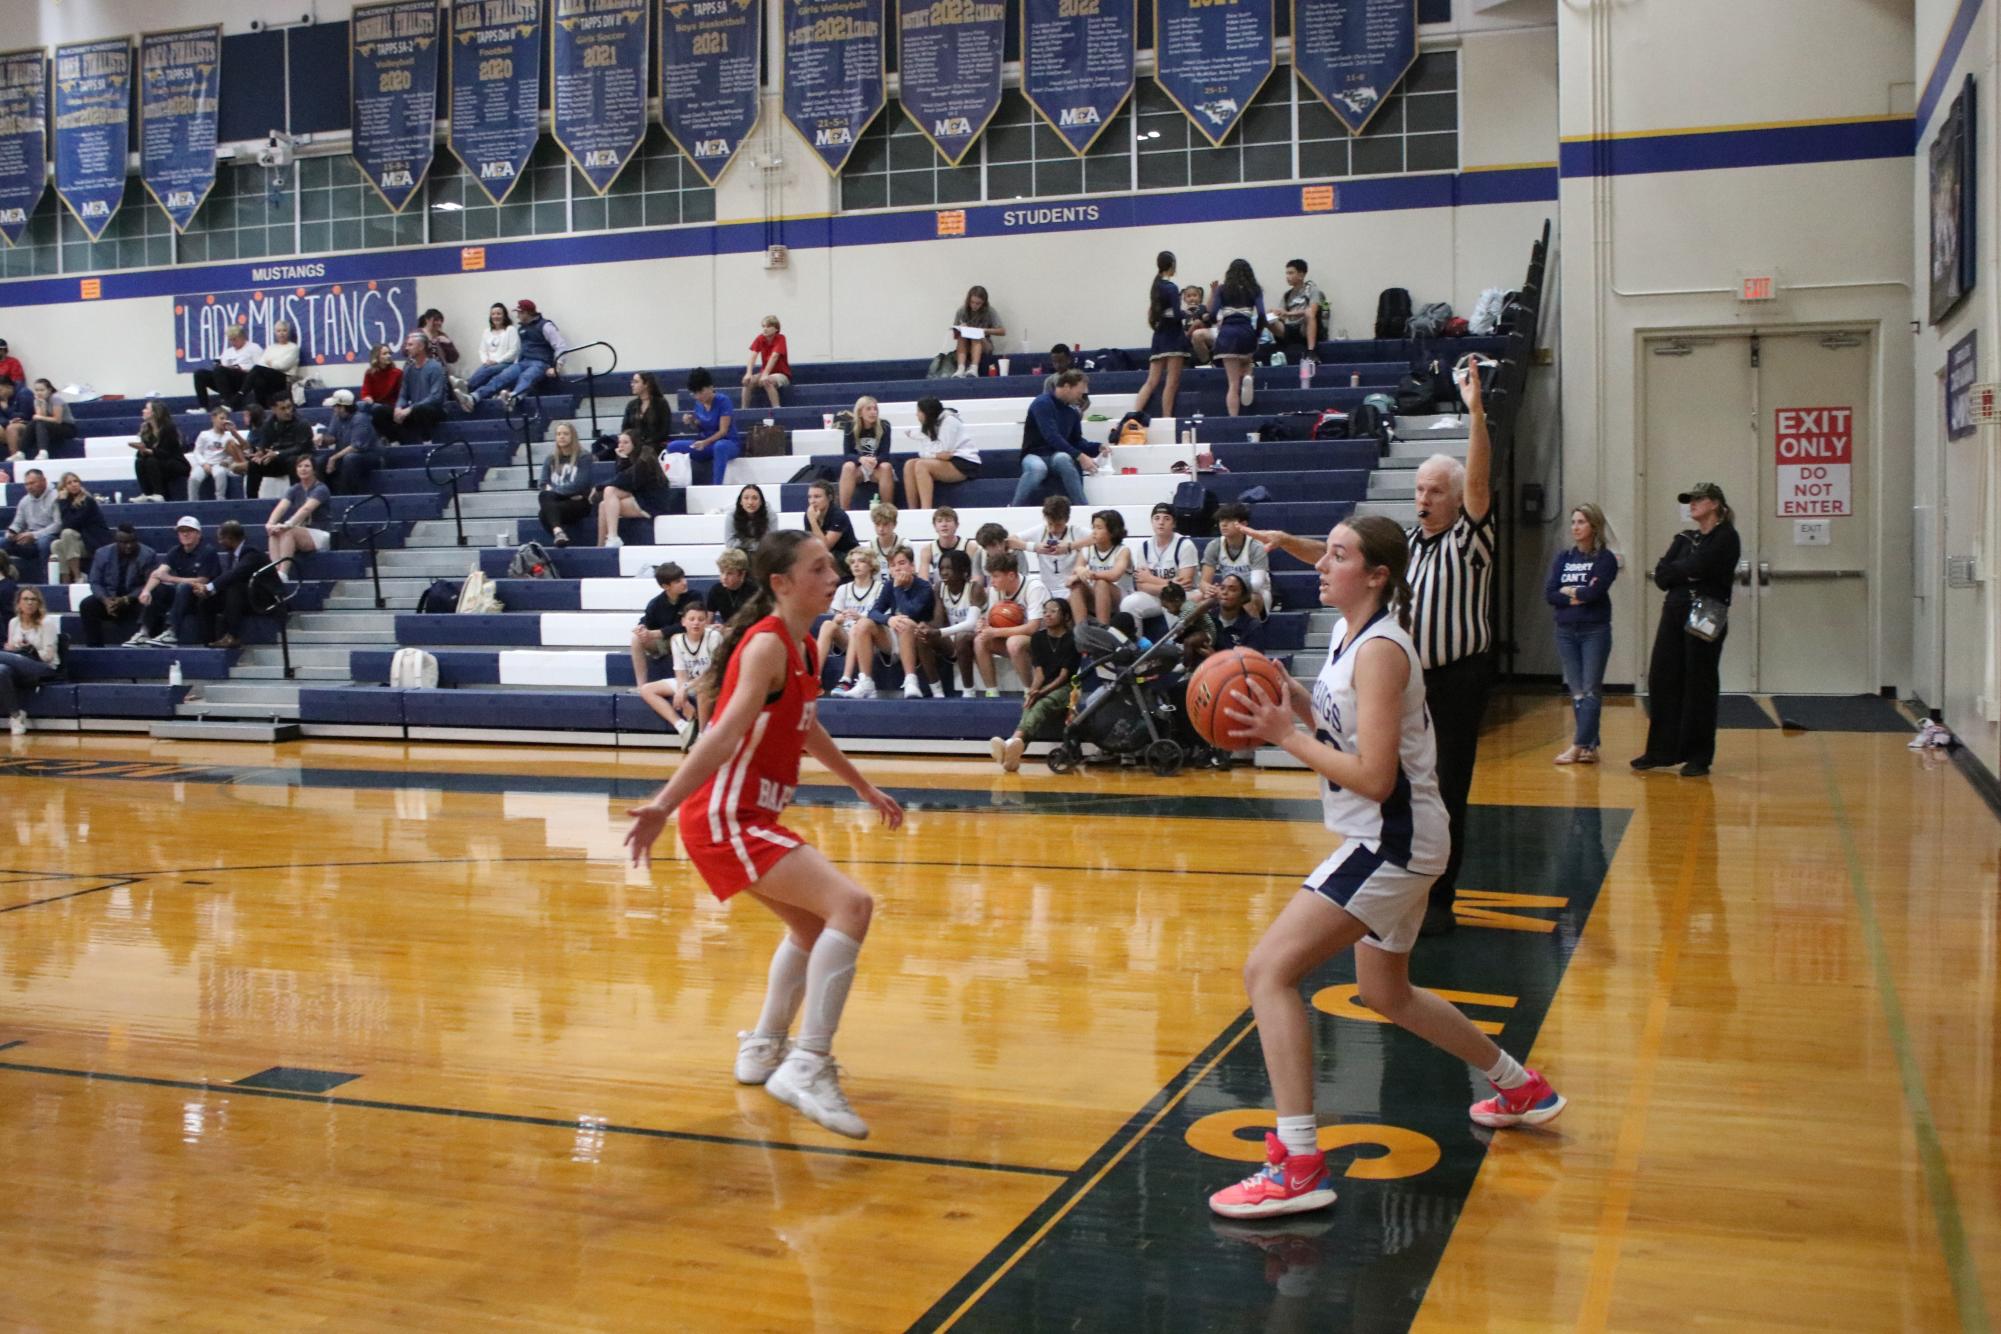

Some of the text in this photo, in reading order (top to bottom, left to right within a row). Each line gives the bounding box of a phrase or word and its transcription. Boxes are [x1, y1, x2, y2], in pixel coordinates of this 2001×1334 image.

[930, 0, 976, 26] 2022
[815, 16, 854, 42] 2021
[692, 32, 728, 56] 2021
[583, 45, 617, 68] 2021
[479, 58, 513, 81] 2020
[379, 70, 412, 92] 2020
[1002, 205, 1100, 227] STUDENTS
[252, 263, 325, 282] MUSTANGS
[1744, 277, 1772, 299] EXIT
[184, 287, 405, 362] LADY MUSTANGS
[1778, 410, 1851, 434] EXIT
[1780, 437, 1848, 458] ONLY
[1800, 467, 1828, 480] DO
[1794, 484, 1833, 497] NOT
[1784, 500, 1844, 514] ENTER
[1800, 525, 1822, 533] EXIT
[1563, 562, 1594, 572] SORRY
